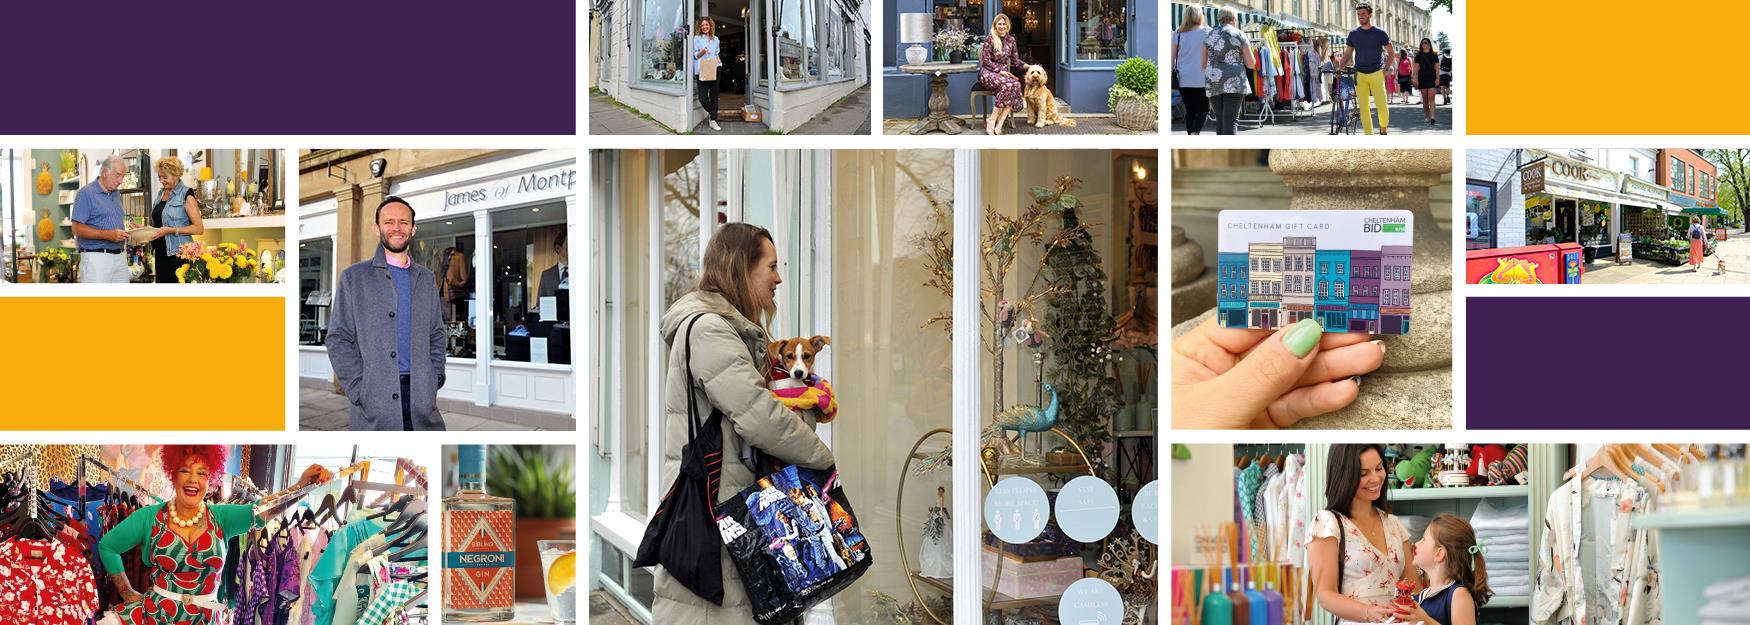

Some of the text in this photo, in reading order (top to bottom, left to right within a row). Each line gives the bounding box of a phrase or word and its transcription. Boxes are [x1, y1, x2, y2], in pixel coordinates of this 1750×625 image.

[1523, 166, 1541, 180] COOK
[1552, 161, 1588, 181] COOK
[442, 189, 488, 212] James
[1227, 222, 1282, 230] CHELTENHAM
[1363, 223, 1382, 233] BID
[459, 553, 505, 563] NEGRONI
[475, 570, 490, 578] GIN
